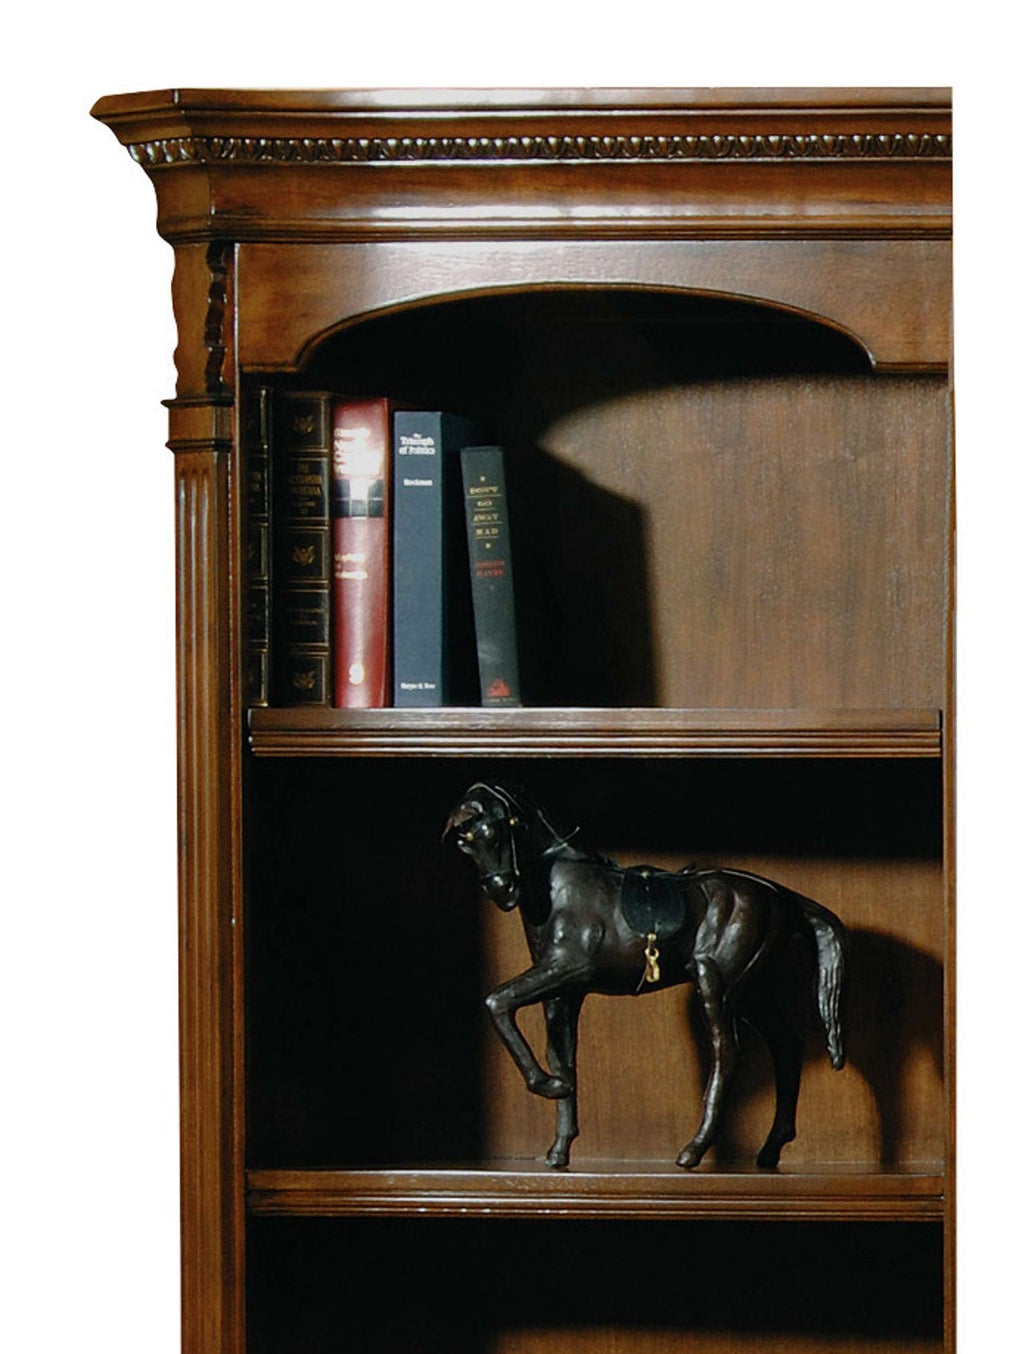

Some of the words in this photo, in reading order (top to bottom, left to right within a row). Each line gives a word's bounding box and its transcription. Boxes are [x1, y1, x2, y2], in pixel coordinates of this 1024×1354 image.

[473, 513, 499, 521] AWAY
[475, 528, 498, 536] MAD
[349, 663, 365, 685] 9
